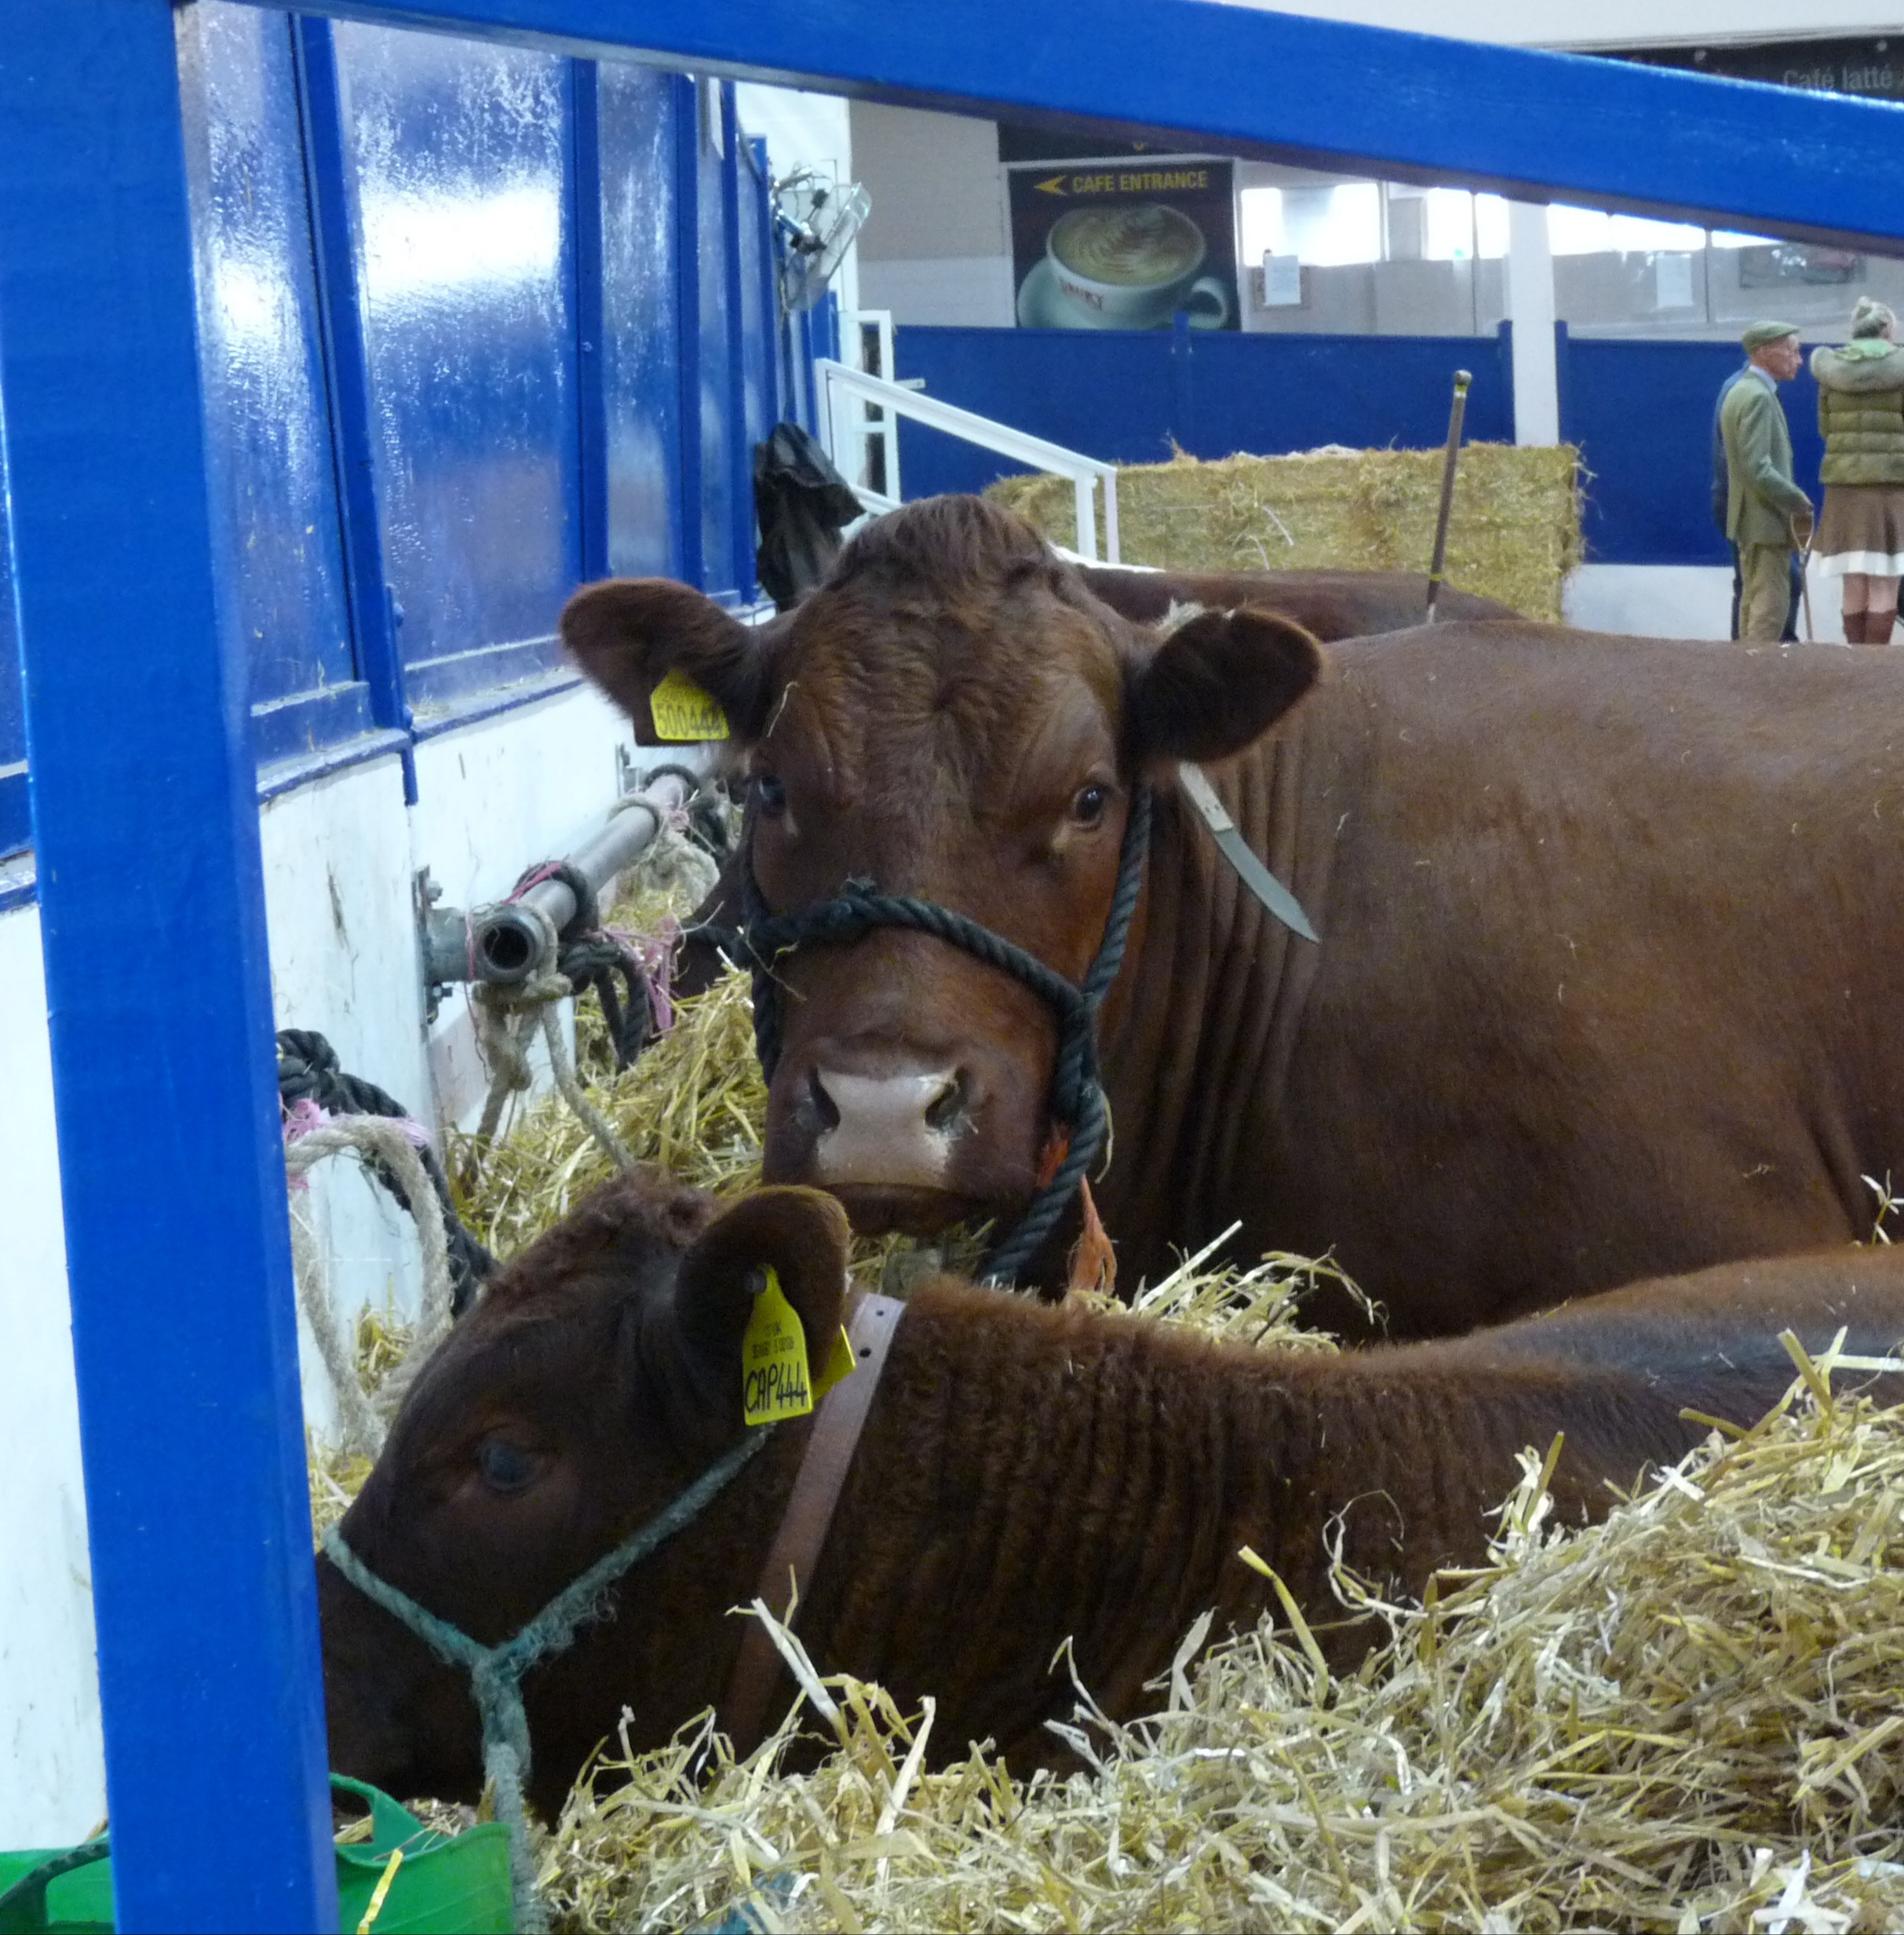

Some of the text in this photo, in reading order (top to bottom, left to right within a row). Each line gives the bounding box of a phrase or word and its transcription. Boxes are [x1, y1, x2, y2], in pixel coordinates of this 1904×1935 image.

[1783, 66, 1834, 89] Café
[1841, 64, 1893, 90] latté
[1072, 170, 1208, 193] CAFE ENTRANCE
[746, 1362, 808, 1413] CAP444
